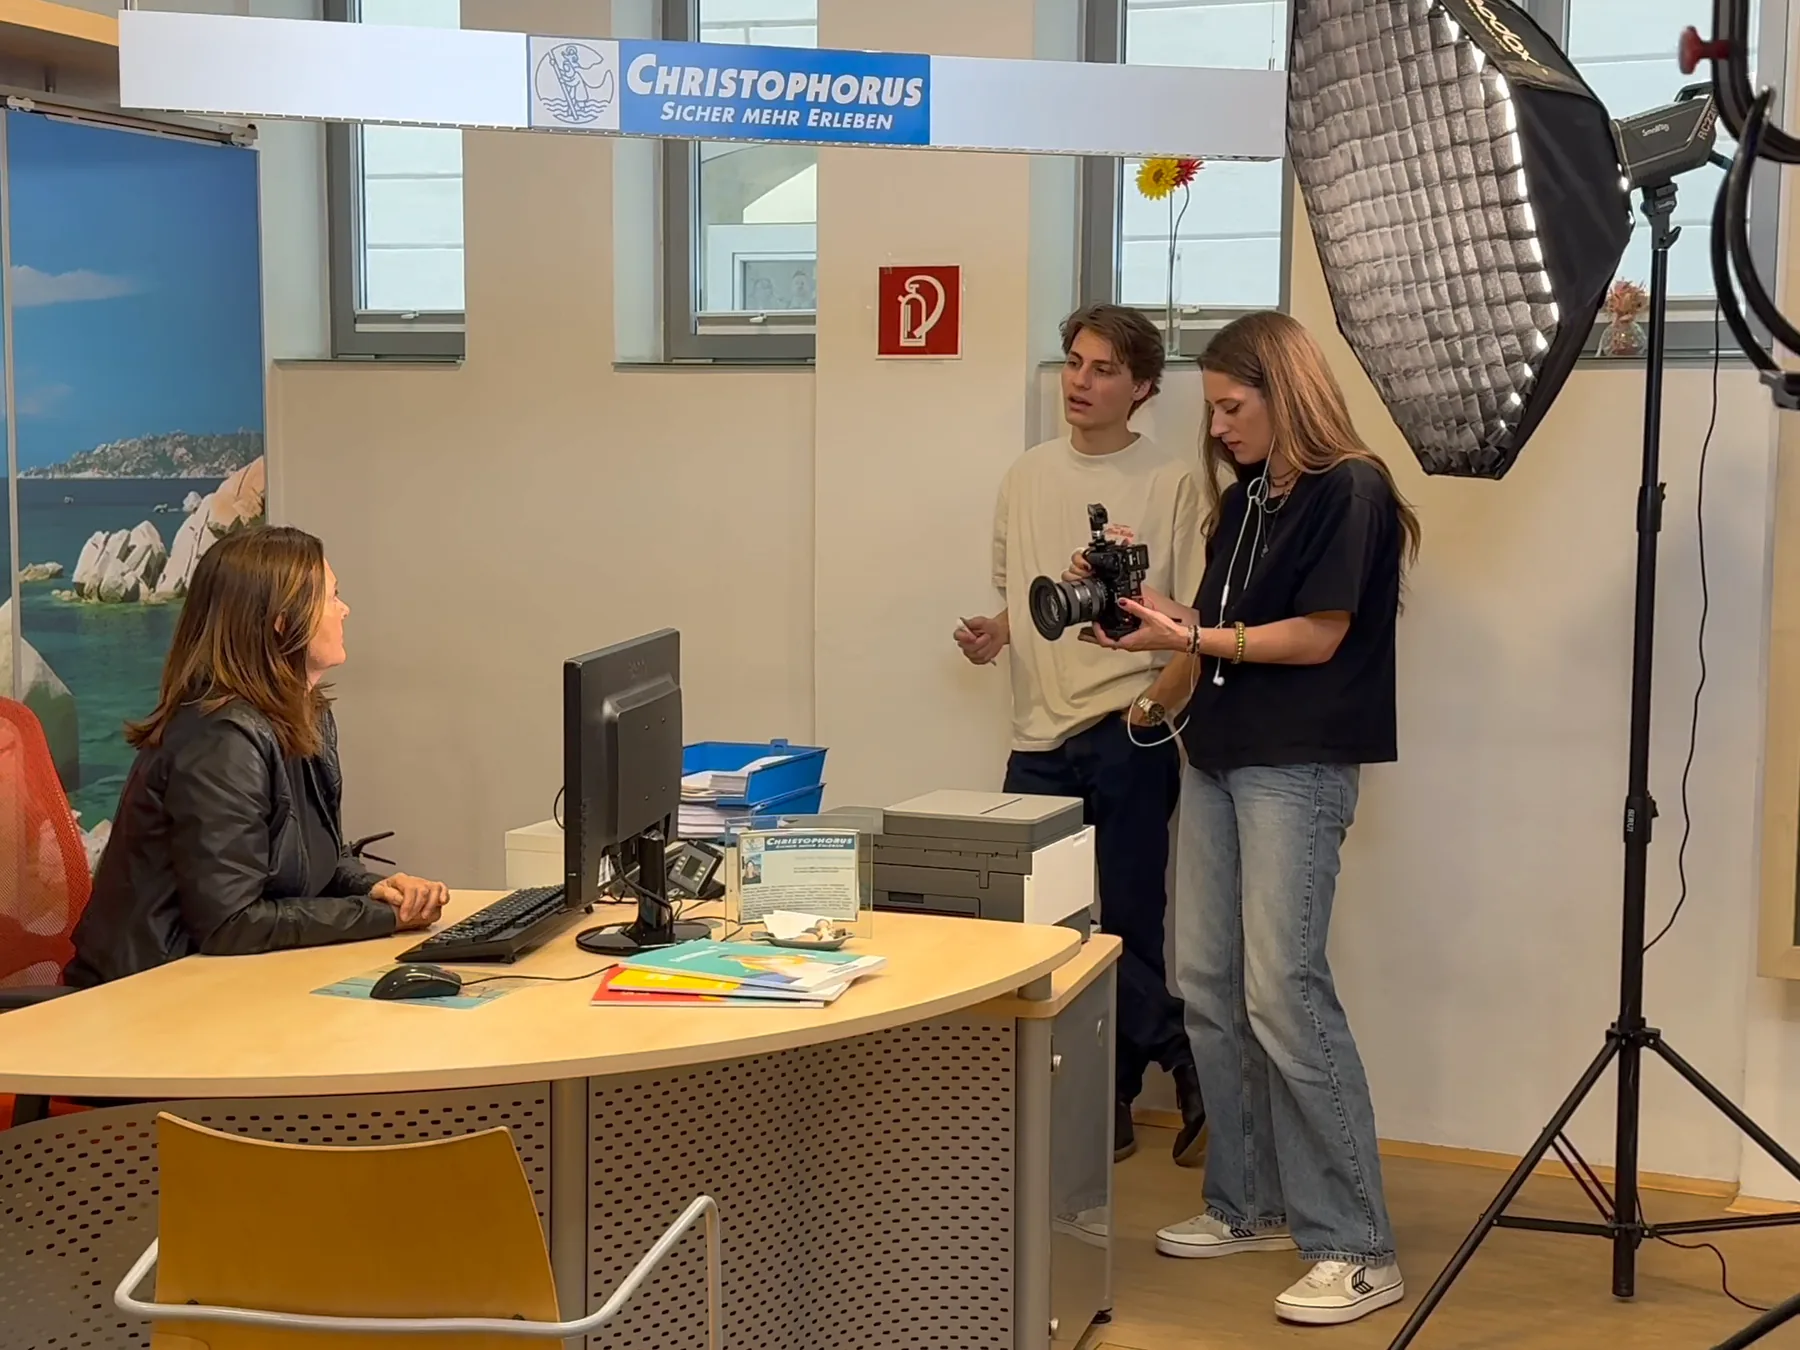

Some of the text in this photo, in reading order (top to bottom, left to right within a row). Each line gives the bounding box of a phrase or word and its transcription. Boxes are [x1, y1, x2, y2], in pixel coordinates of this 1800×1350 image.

[626, 53, 923, 108] CHRISTOPHORUS
[660, 101, 893, 131] SICHER MEHR ERLEBEN
[766, 837, 853, 846] CHRISTOPHORUS
